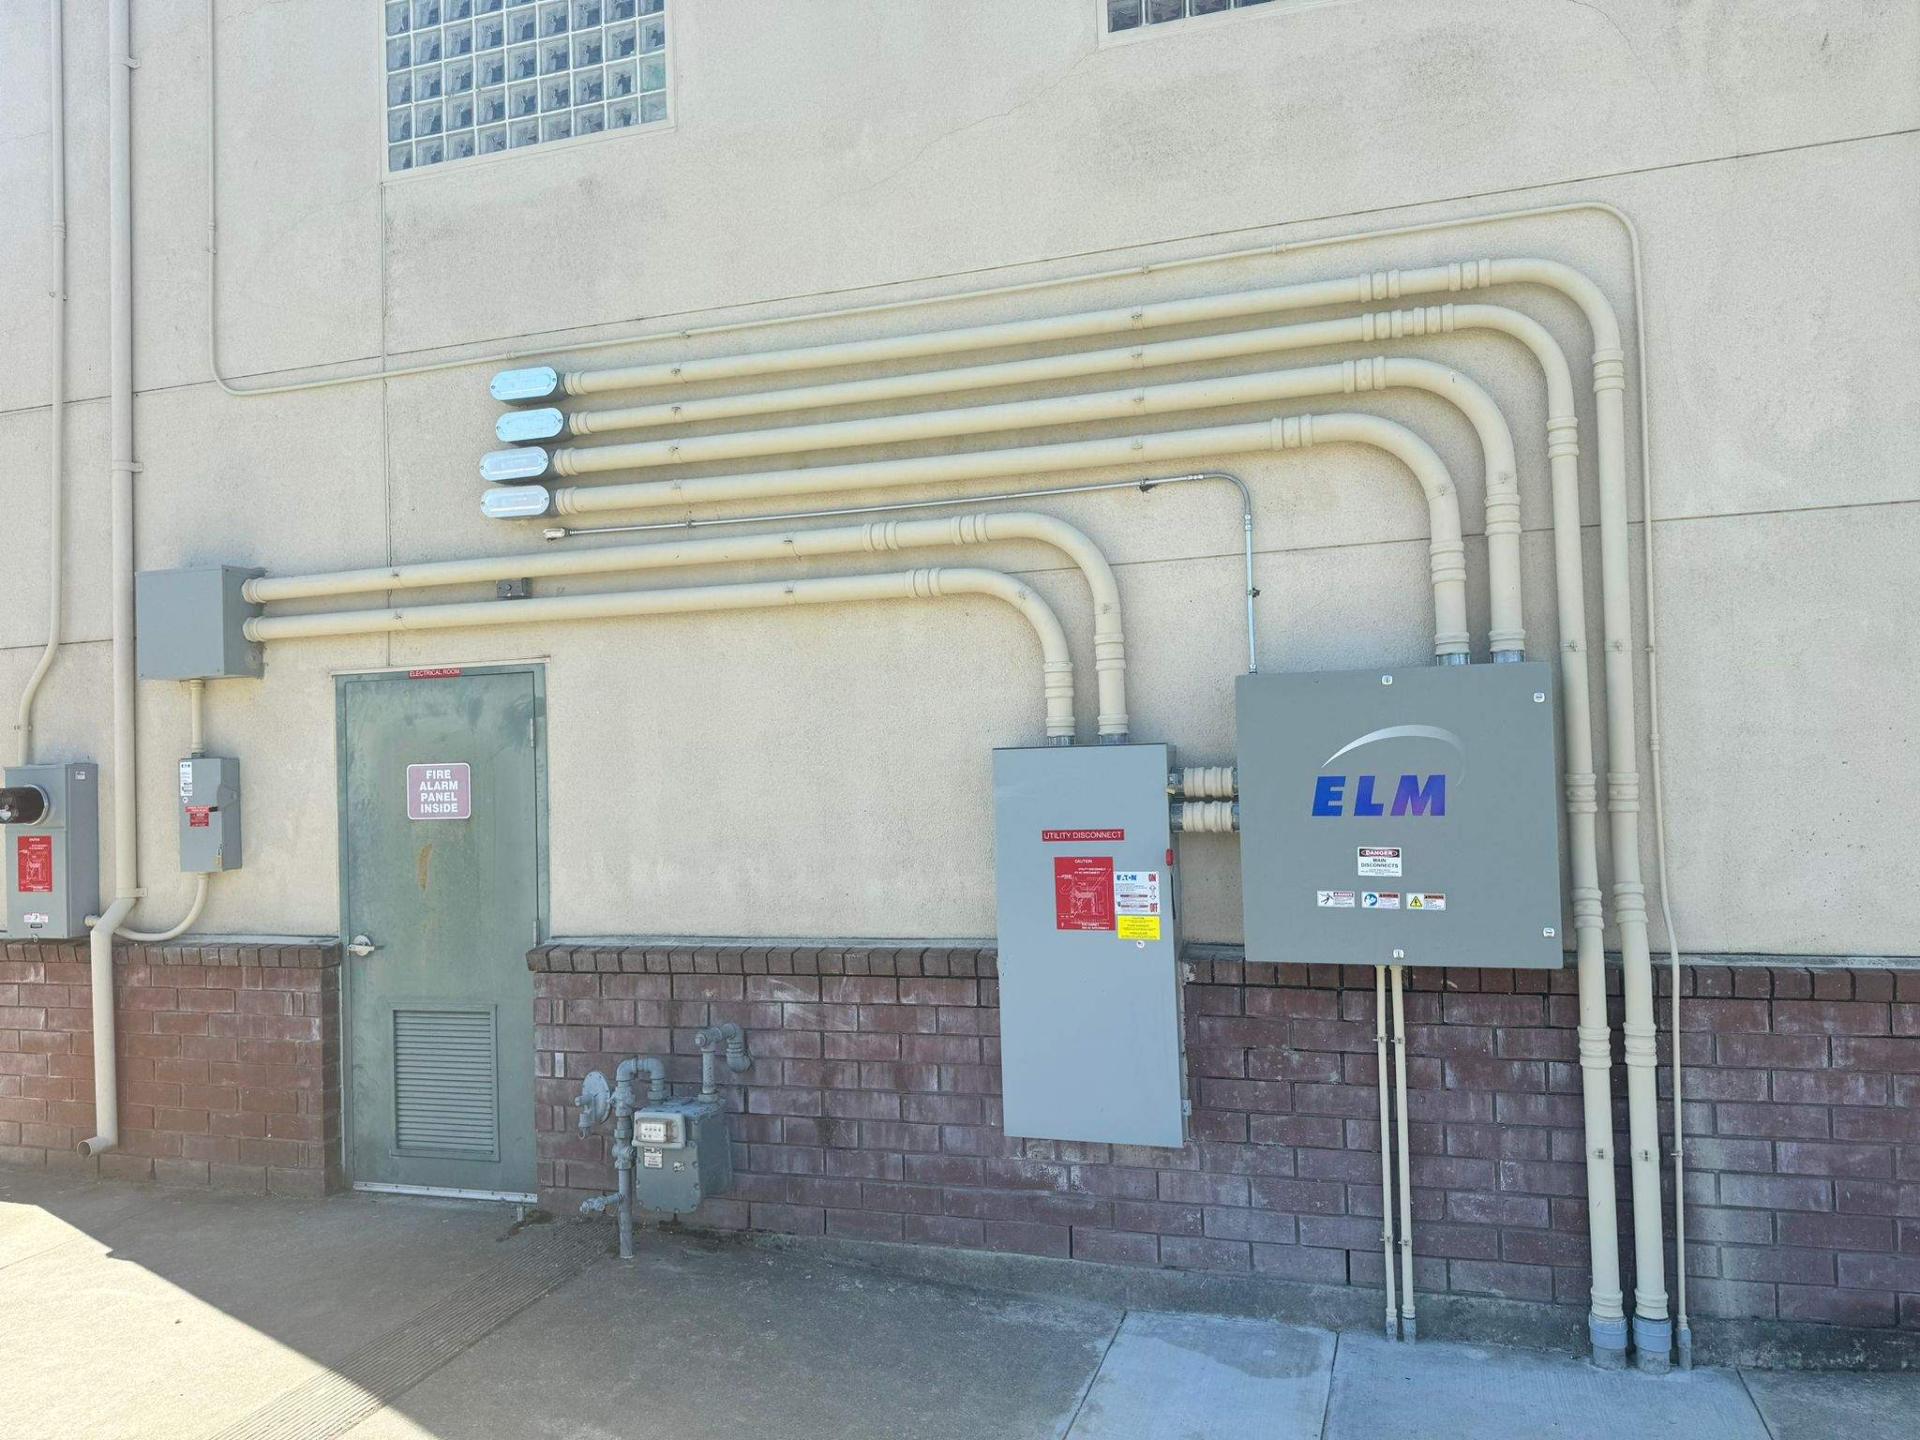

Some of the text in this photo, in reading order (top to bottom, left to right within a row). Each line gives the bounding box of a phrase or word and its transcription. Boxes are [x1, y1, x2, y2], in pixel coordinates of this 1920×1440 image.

[409, 668, 460, 677] ELECTRICAL ROOM
[426, 770, 451, 779] FIRE
[419, 780, 458, 791] ALARM
[420, 792, 457, 802] PANEL
[1312, 774, 1446, 816] ELM
[420, 803, 458, 813] INSIDE
[1044, 831, 1122, 840] UTILITY DISCONNECT
